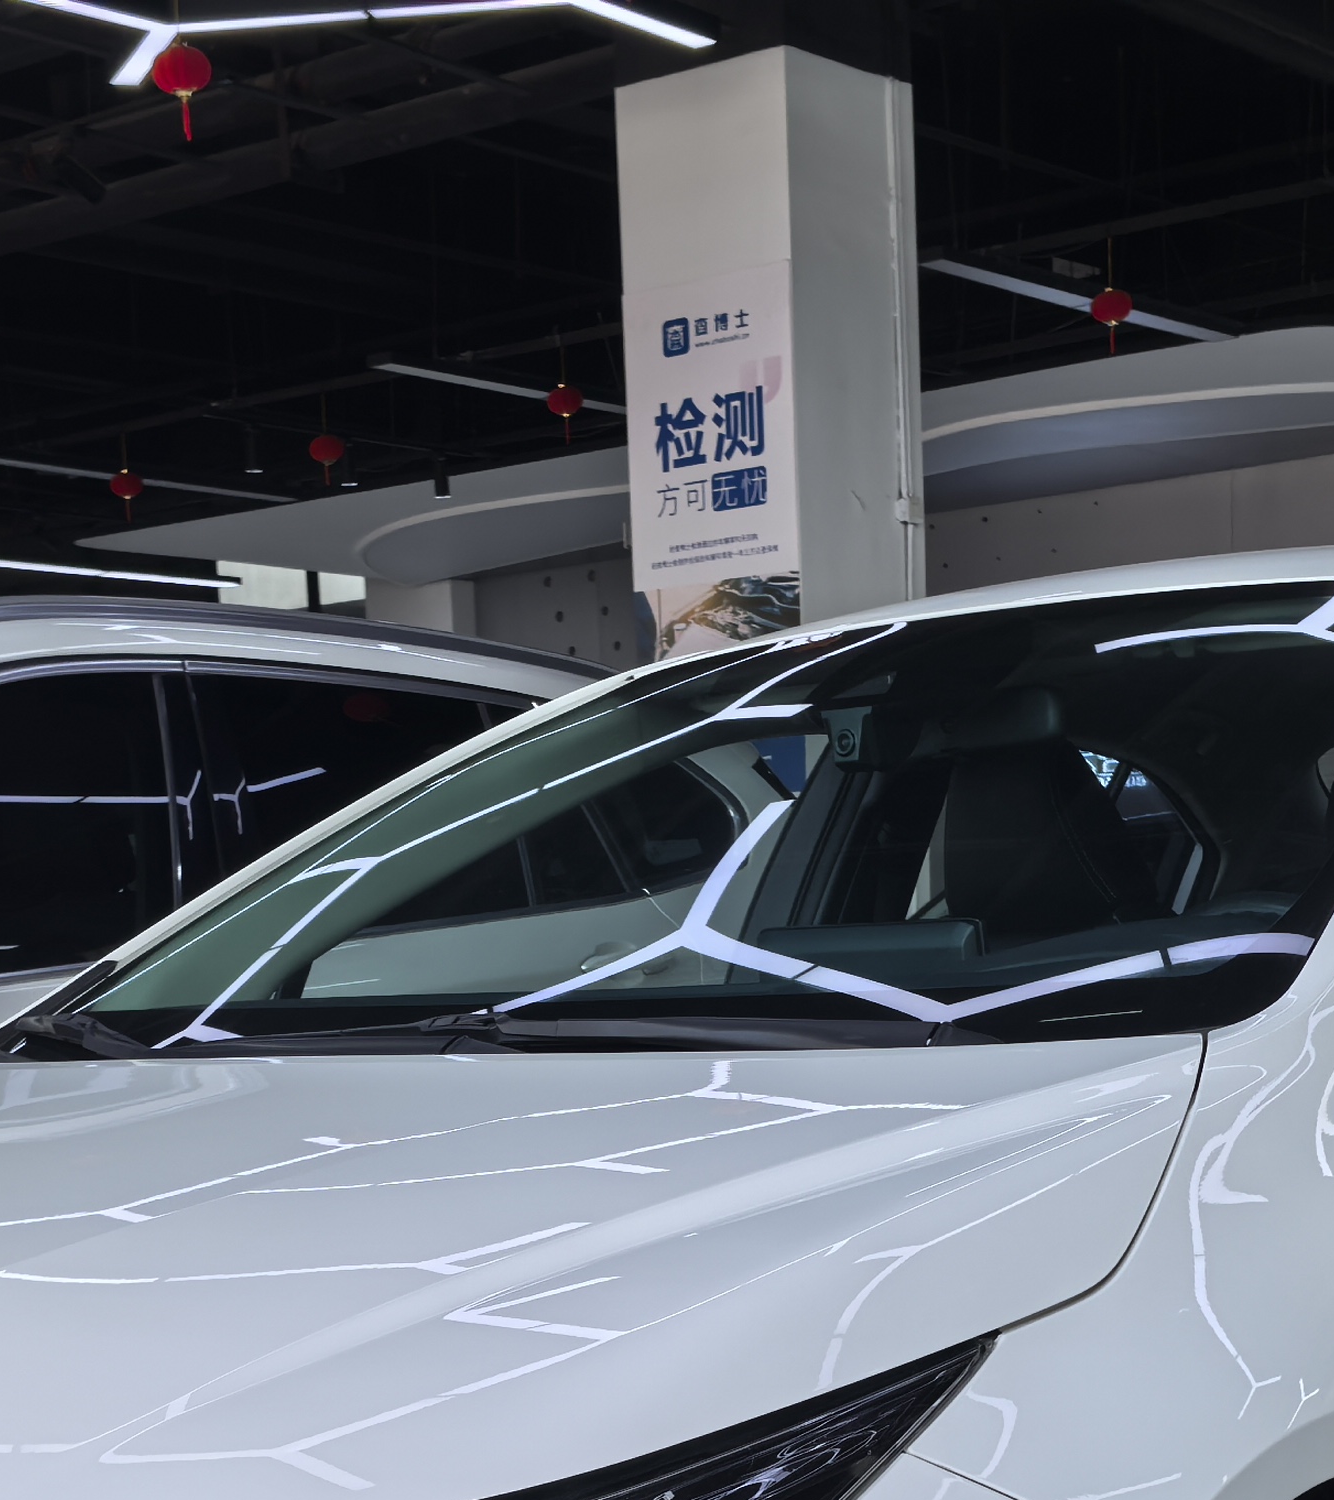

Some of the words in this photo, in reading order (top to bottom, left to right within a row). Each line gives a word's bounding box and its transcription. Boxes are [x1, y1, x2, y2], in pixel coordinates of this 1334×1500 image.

[655, 385, 765, 474] 检测
[657, 470, 767, 518] 方可无忧
